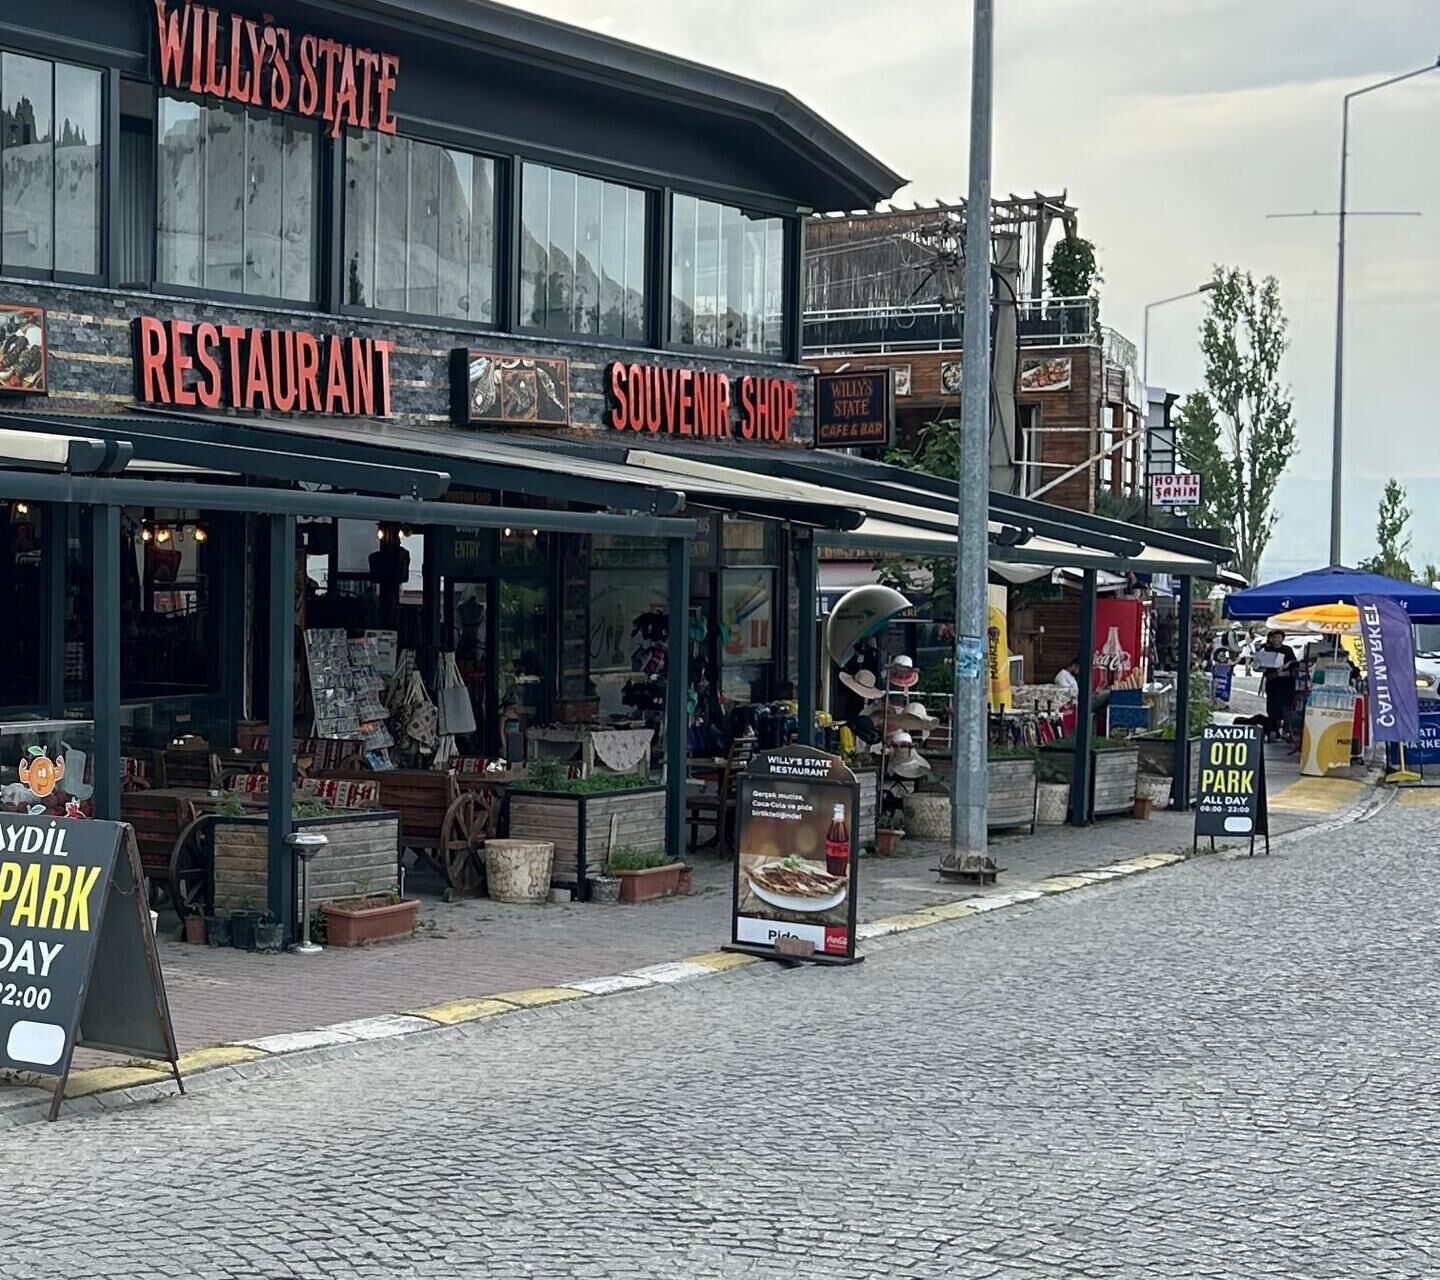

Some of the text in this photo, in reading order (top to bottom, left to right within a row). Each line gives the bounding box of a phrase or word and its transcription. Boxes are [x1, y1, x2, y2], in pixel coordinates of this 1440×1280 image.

[298, 33, 400, 139] STATE
[138, 316, 397, 418] RESTAURANT
[830, 378, 873, 398] WILLY'S
[610, 361, 798, 441] SOUVENIR SHOP
[833, 398, 869, 419] STATE
[820, 422, 883, 438] CAFE & BAR
[1155, 475, 1198, 486] HOTEL
[1203, 726, 1257, 739] BAYDİL
[767, 755, 832, 768] WILLY'S STATE
[1210, 742, 1248, 766] OTO
[769, 765, 829, 777] RESTAURANT
[1201, 769, 1255, 794] PARK
[752, 800, 786, 810] Coca-Cola
[1203, 796, 1248, 805] ALL DAY
